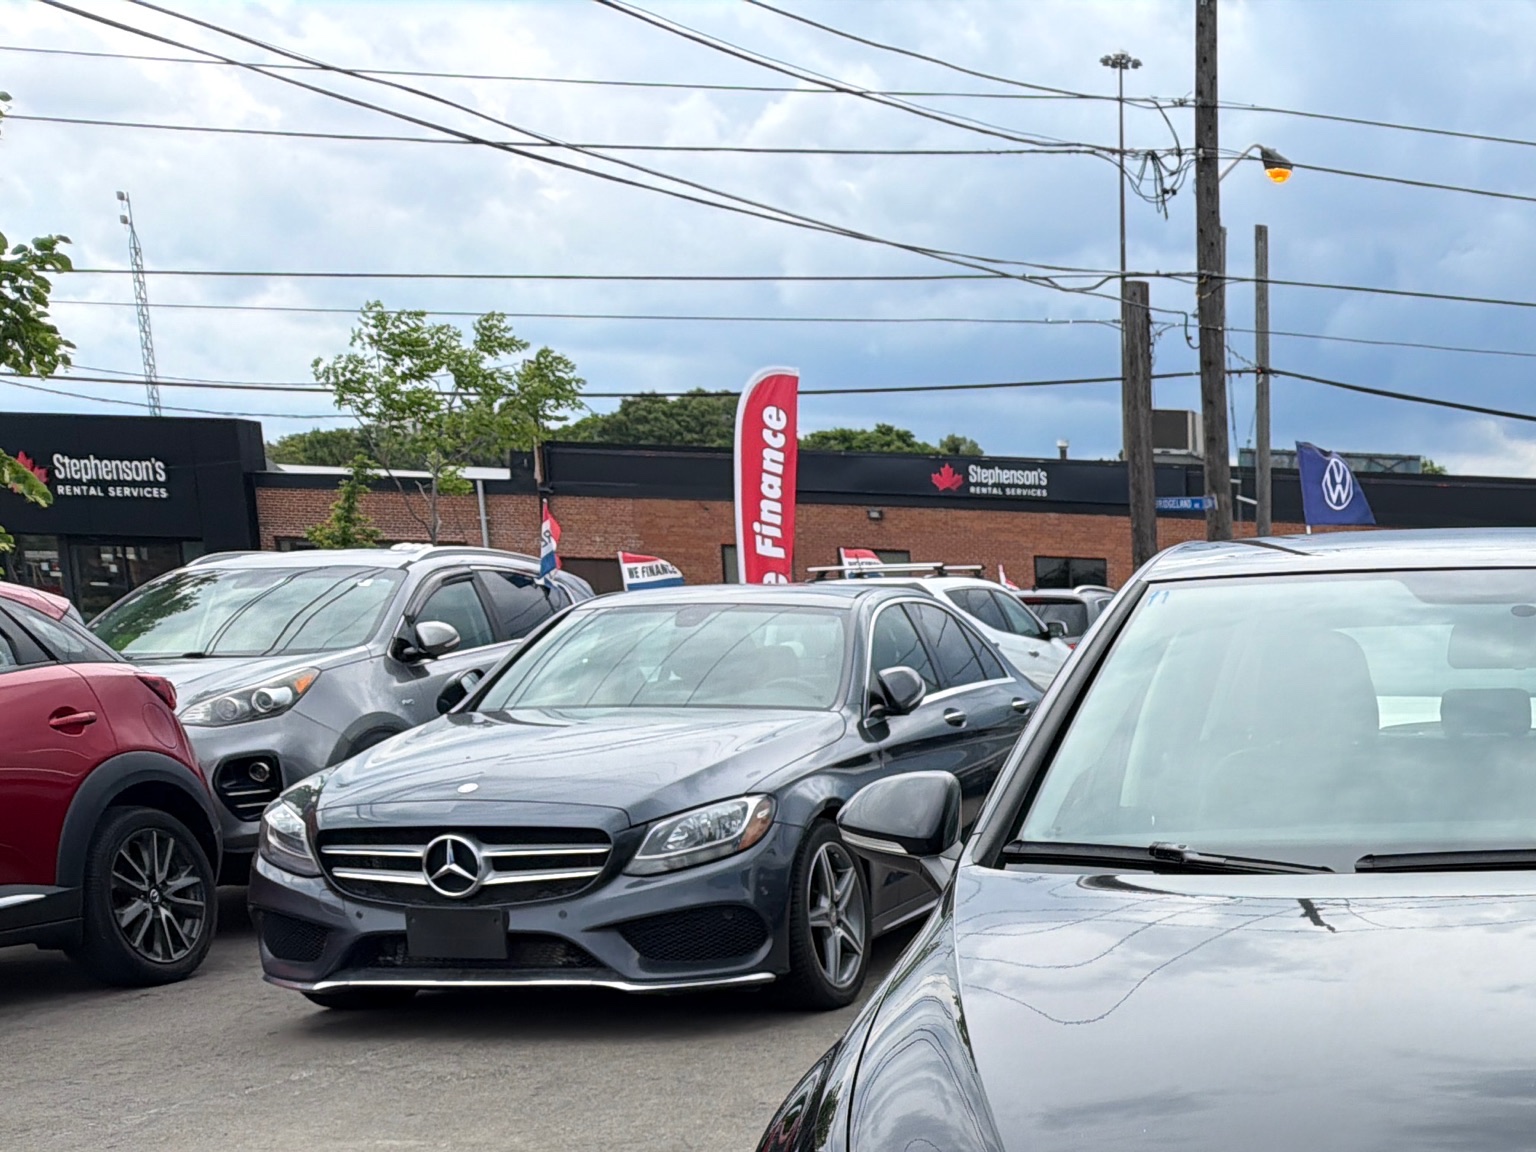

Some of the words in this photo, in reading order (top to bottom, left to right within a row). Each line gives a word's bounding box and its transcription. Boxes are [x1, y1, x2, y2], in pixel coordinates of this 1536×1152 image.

[52, 453, 166, 482] Stephenson's
[968, 464, 1048, 486] Stephenson's
[57, 485, 104, 496] RENTAL
[108, 486, 168, 498] SERVICES
[753, 405, 788, 559] Finance
[969, 486, 1003, 495] RENTAL
[1005, 487, 1048, 497] SERVICES
